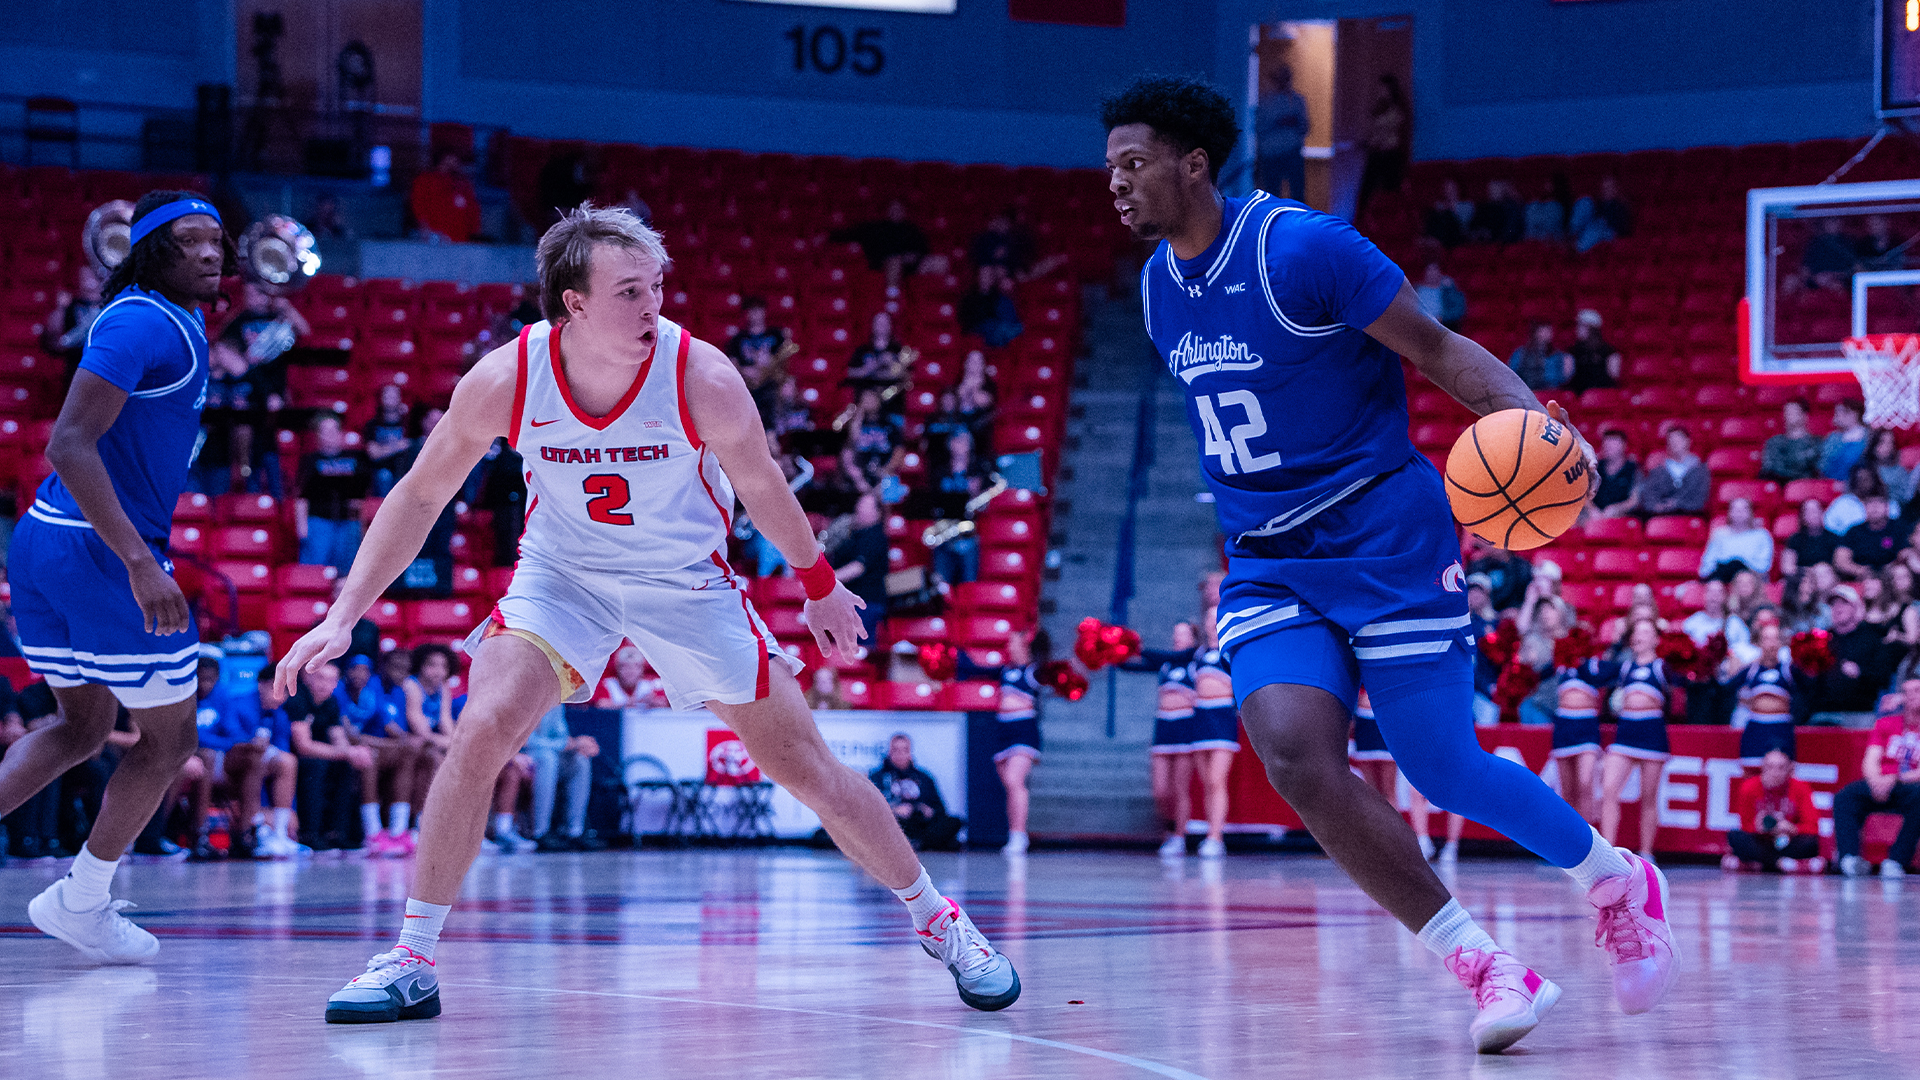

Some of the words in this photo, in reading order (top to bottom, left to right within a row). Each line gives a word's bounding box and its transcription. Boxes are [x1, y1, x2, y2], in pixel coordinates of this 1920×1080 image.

[785, 25, 885, 76] 105
[1225, 282, 1246, 294] WAC
[1169, 331, 1263, 378] Arlington
[540, 446, 602, 464] UTAH
[605, 444, 669, 463] TECH
[1195, 389, 1282, 476] 42
[582, 473, 635, 526] 2
